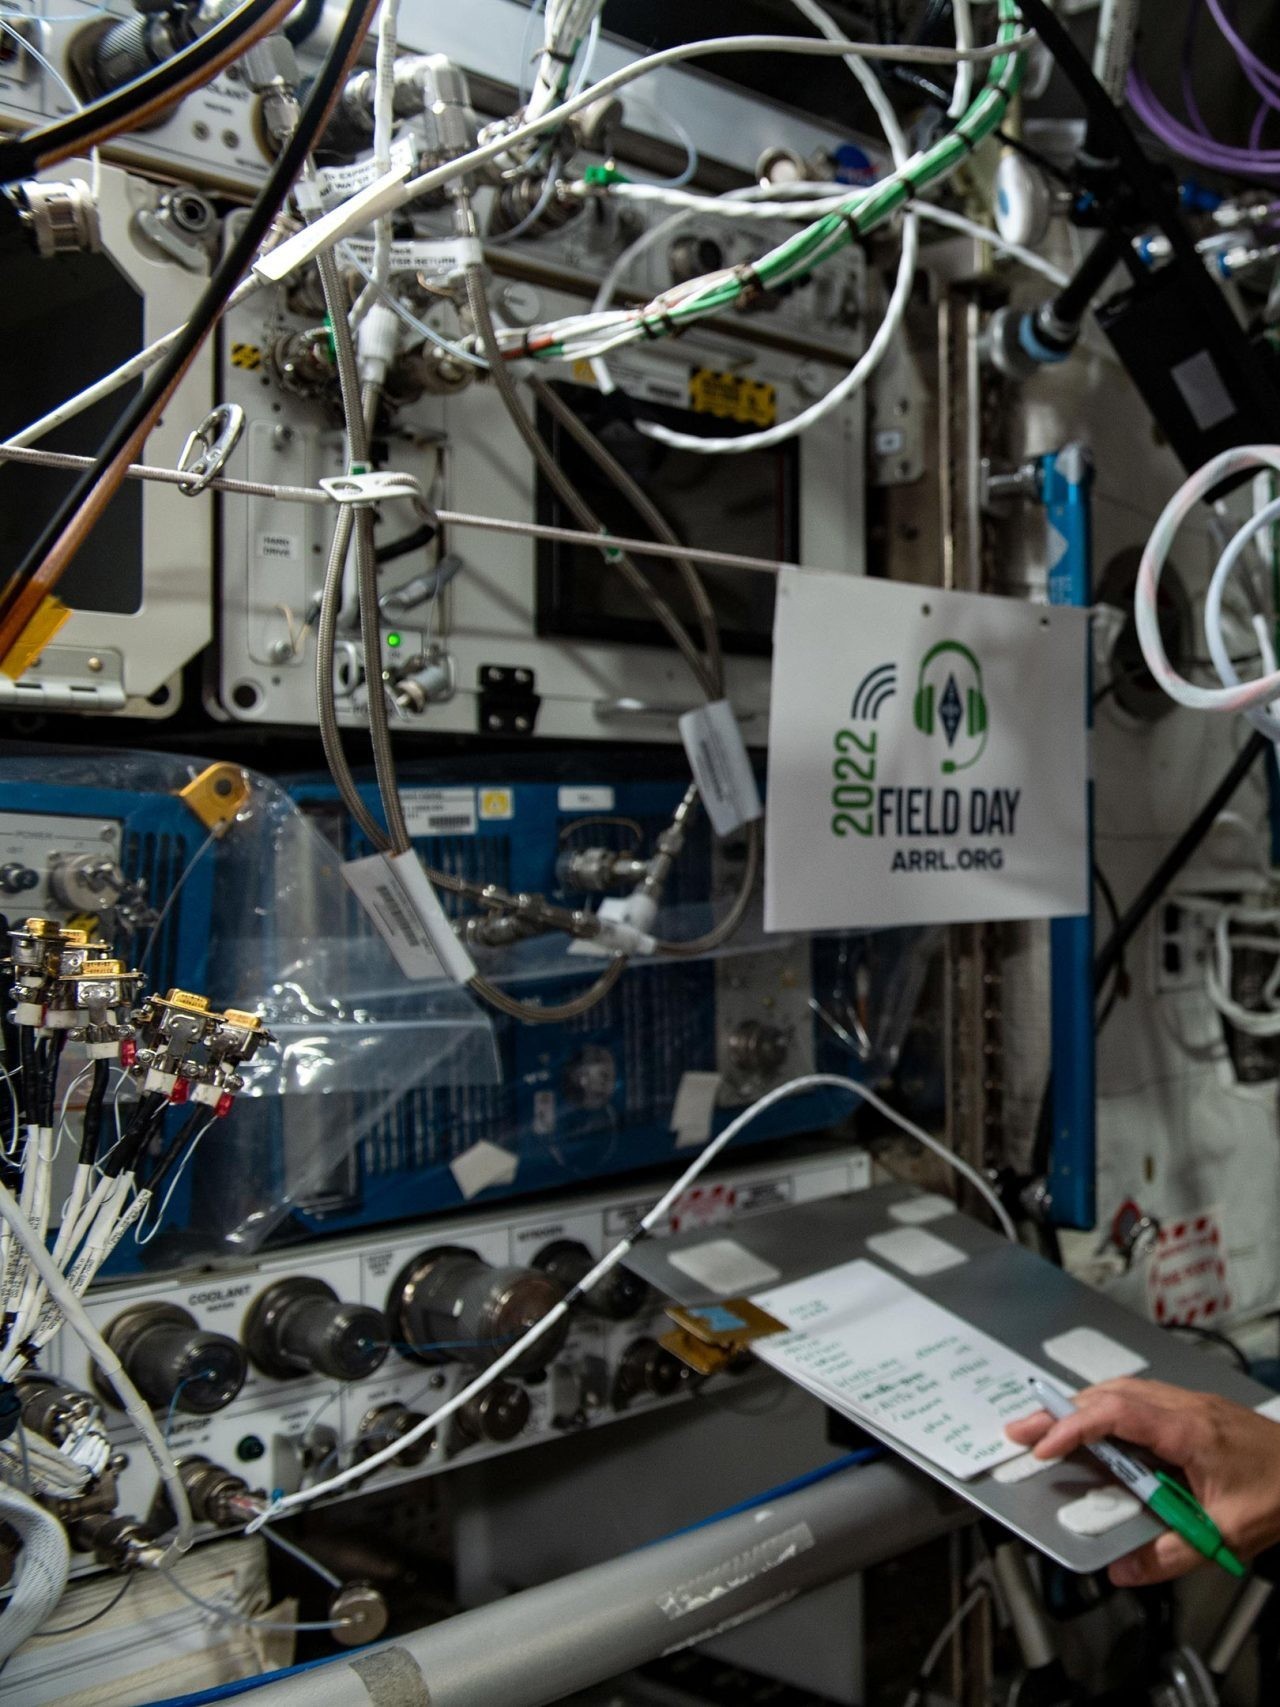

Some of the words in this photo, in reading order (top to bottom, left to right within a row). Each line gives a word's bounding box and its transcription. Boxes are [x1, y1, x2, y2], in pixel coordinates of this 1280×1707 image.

[831, 729, 877, 838] 2022
[877, 786, 962, 838] FIELD
[968, 787, 1021, 837] DAY
[891, 849, 1004, 873] ARRL.ORG
[187, 1283, 251, 1306] COOLANT
